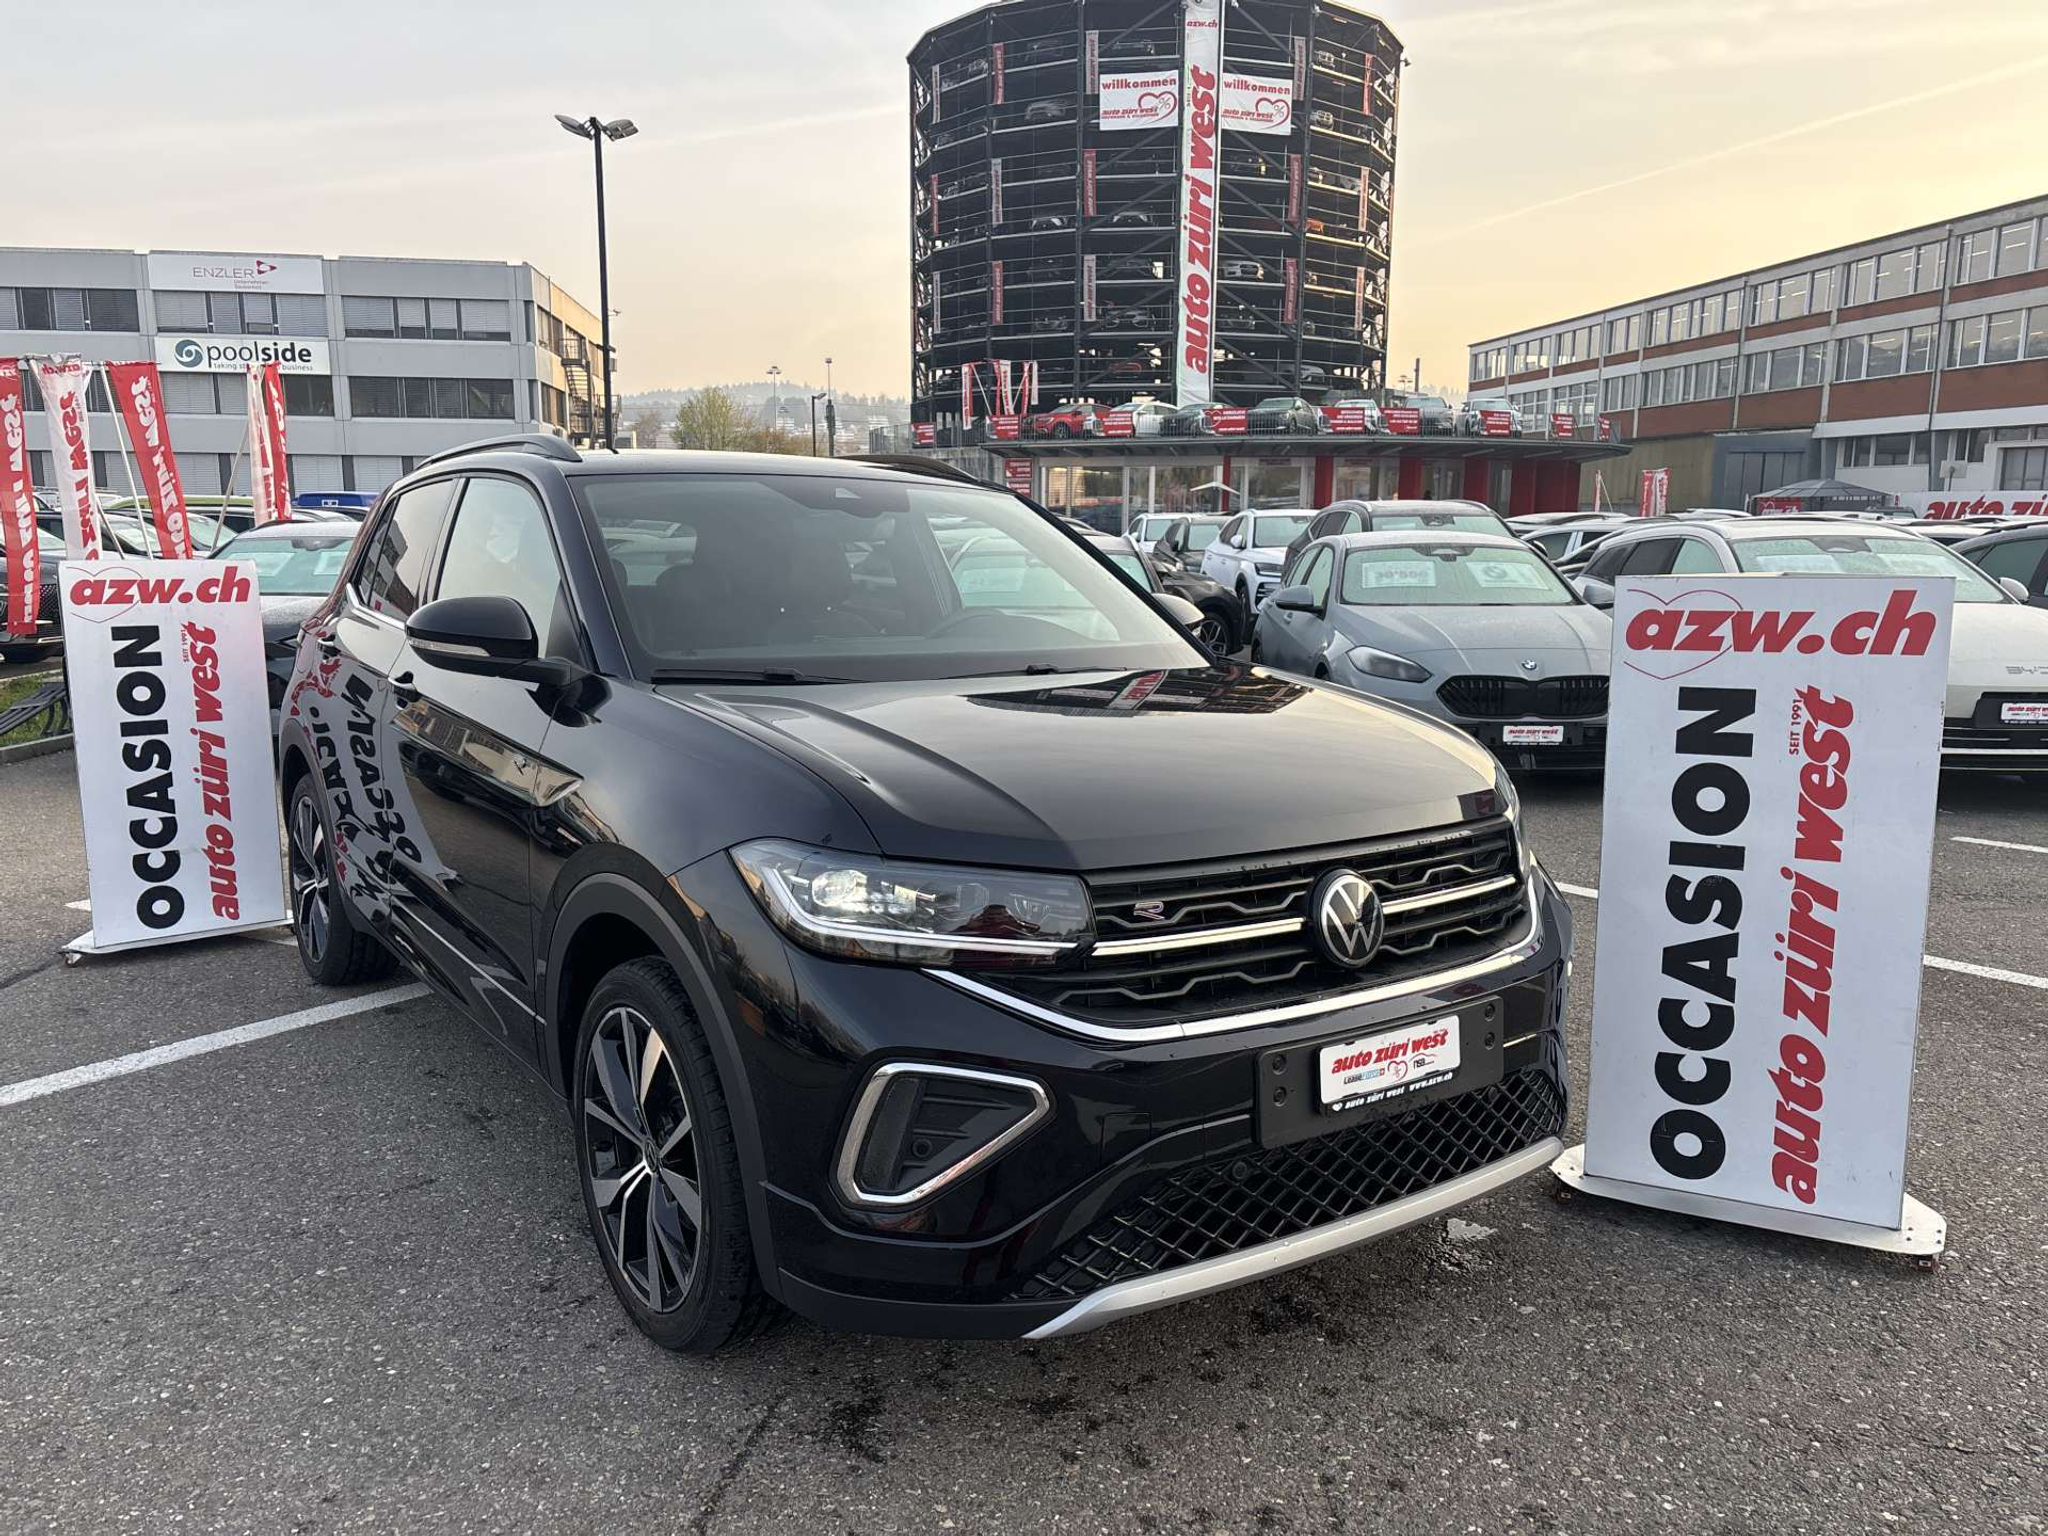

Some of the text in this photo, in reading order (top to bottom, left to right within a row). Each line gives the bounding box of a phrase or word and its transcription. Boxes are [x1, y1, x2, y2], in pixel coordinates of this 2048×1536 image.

[1187, 19, 1218, 28] azw.ch
[1101, 78, 1177, 90] willkommen
[1223, 79, 1291, 95] willkommen
[1182, 65, 1216, 374] auto züri west
[193, 266, 255, 279] ENZLER
[206, 341, 312, 368] poolside
[213, 362, 237, 370] taking
[282, 363, 313, 371] business
[70, 566, 251, 606] azw.ch
[1625, 589, 1936, 657] azw.ch
[1788, 697, 1803, 755] SEIT 1991
[111, 625, 185, 929] OCCASION
[180, 621, 240, 921] auto züri west
[1650, 687, 1757, 1180] OCCASION
[1766, 685, 1854, 1204] auto züri west
[1331, 1029, 1449, 1075] auto züri west
[1345, 1098, 1365, 1110] auto
[1366, 1091, 1384, 1103] züri
[1386, 1086, 1405, 1098] west
